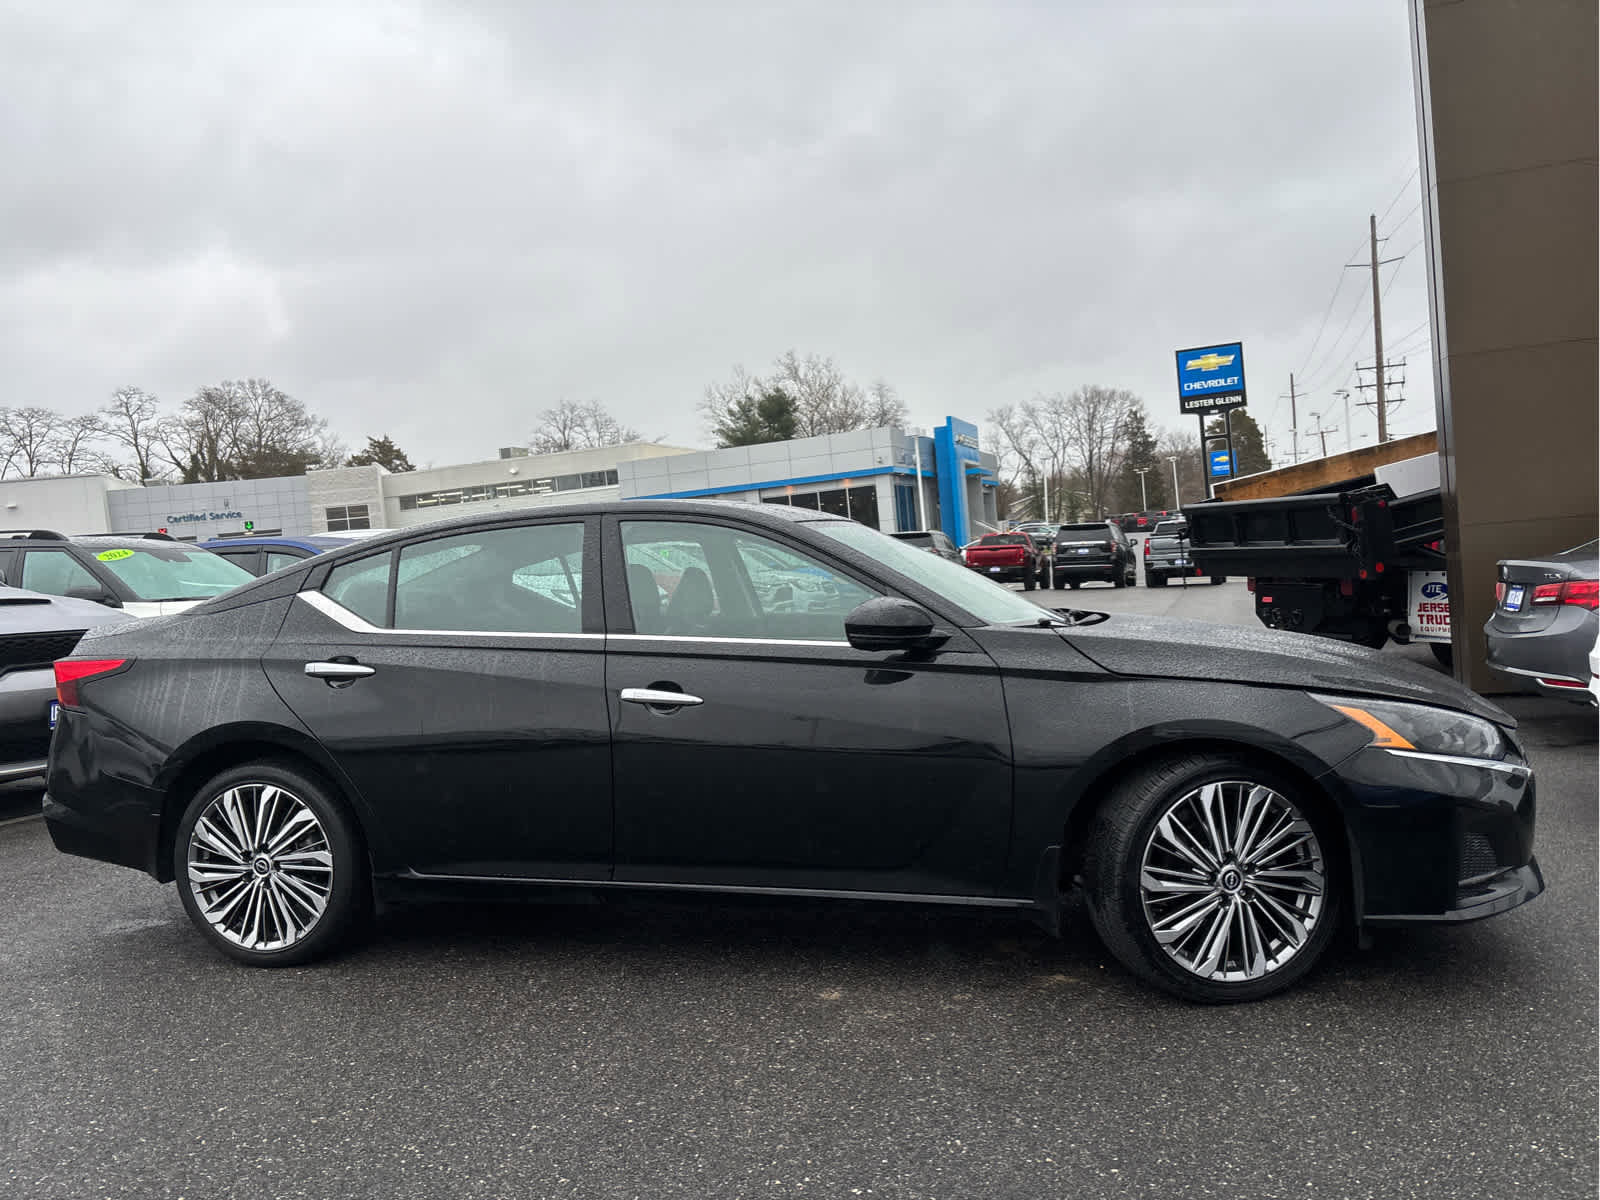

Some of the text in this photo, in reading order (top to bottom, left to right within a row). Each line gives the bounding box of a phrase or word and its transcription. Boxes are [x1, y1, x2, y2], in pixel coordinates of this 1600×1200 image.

[1184, 376, 1239, 391] CHEVROLET
[1185, 395, 1242, 408] LESTER GLENN
[167, 511, 242, 523] Certified Service
[1426, 584, 1443, 593] JTE
